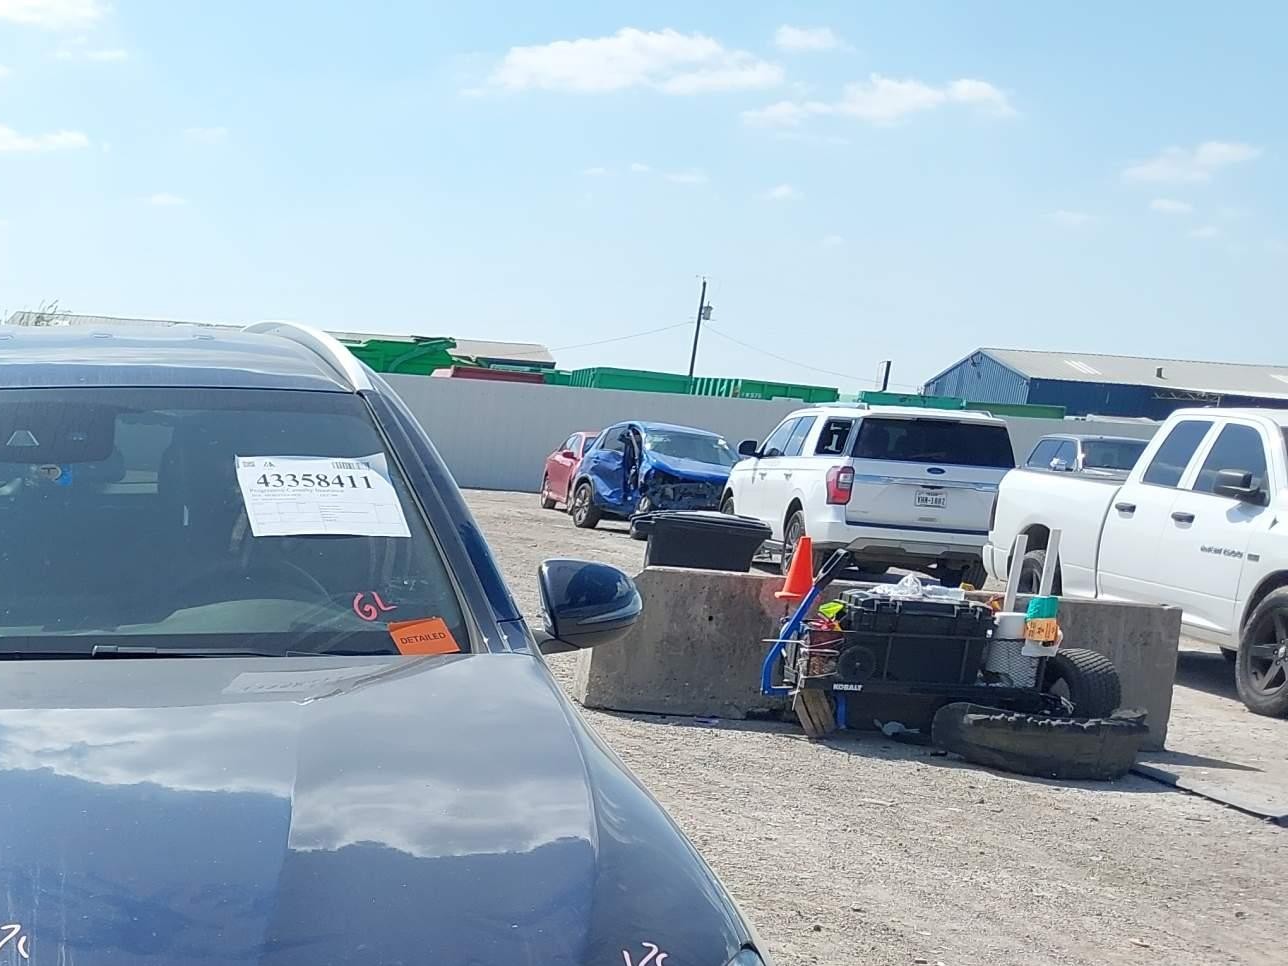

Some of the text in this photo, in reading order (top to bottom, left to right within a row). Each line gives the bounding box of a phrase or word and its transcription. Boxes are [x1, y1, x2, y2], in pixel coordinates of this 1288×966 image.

[256, 473, 376, 490] 43358411
[400, 632, 446, 645] DETAILED
[833, 683, 863, 691] KOBALT
